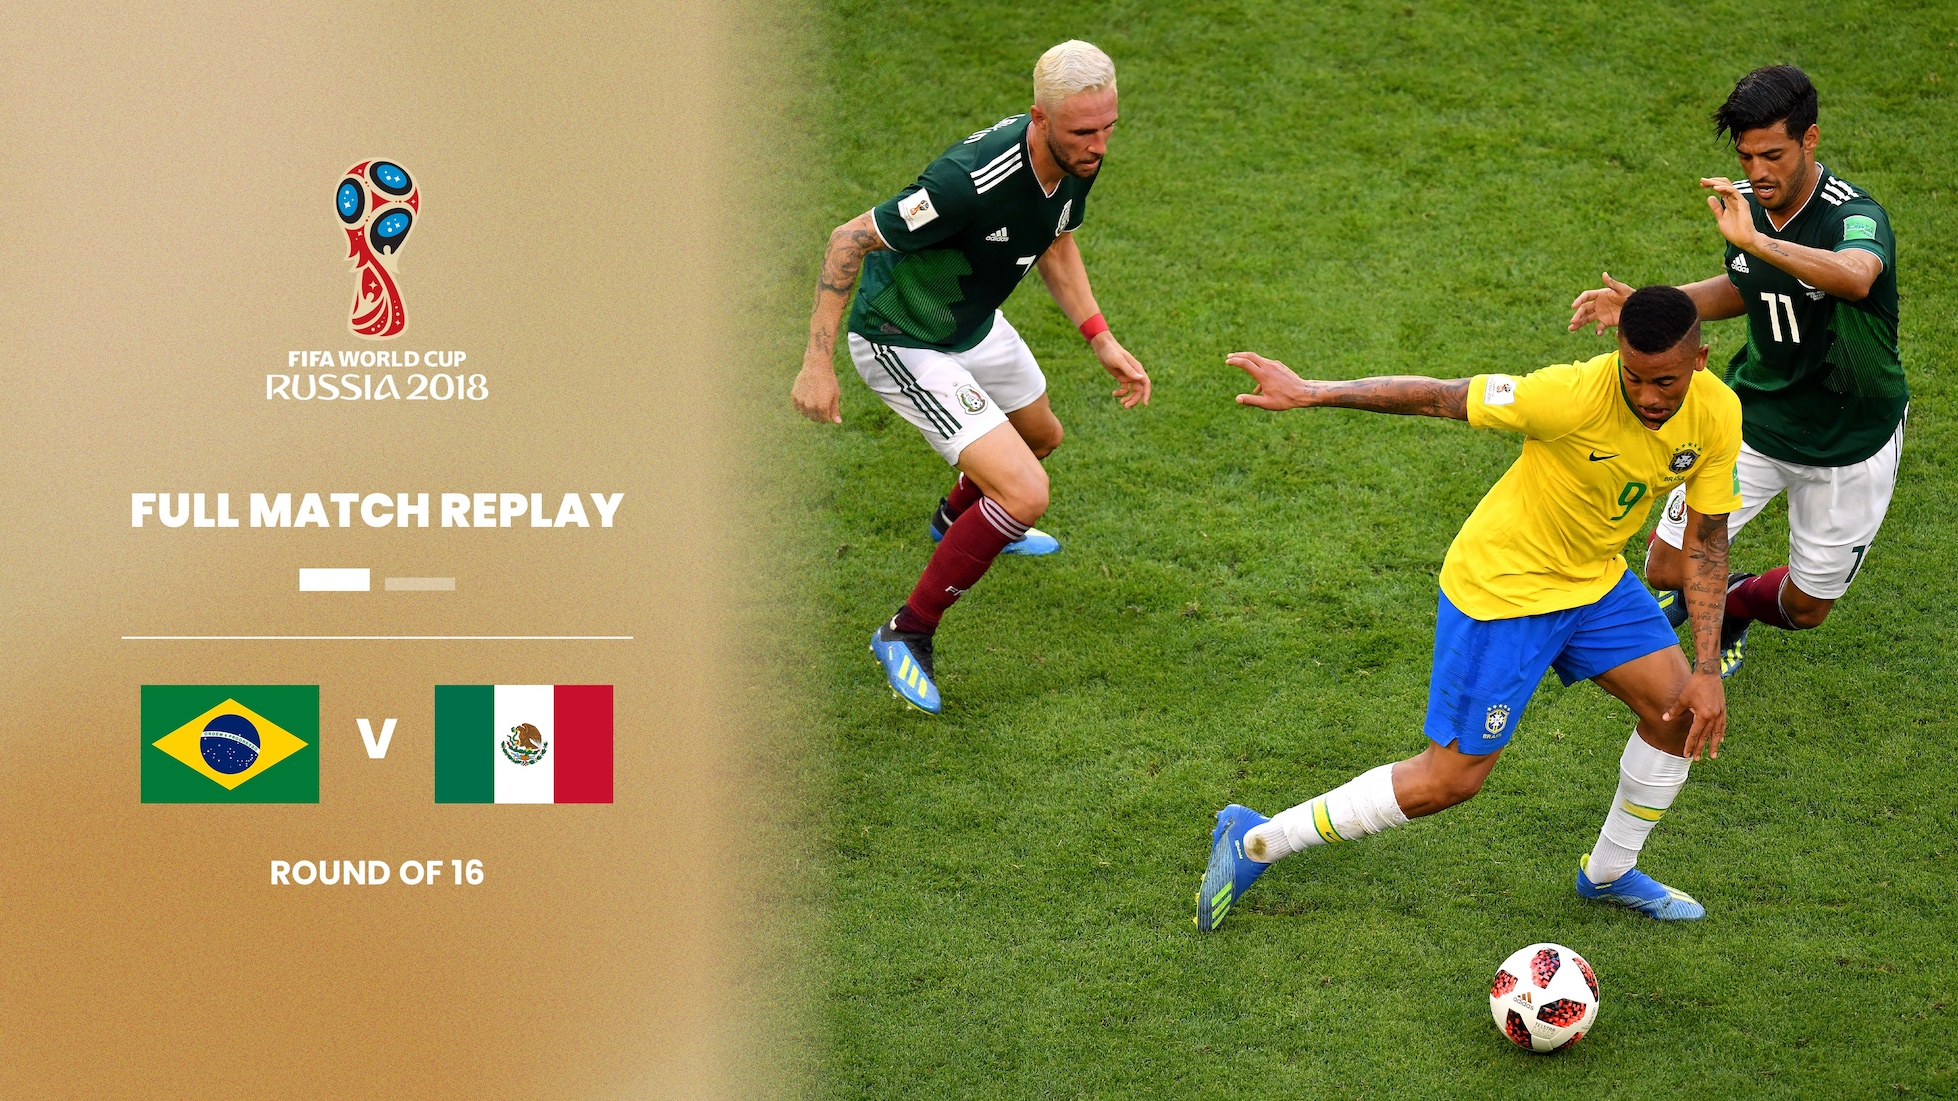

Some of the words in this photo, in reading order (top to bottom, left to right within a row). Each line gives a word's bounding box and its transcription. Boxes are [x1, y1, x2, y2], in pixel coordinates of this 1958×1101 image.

[1015, 254, 1037, 277] 7
[1760, 292, 1800, 344] 11
[1610, 481, 1647, 521] 9
[1513, 997, 1534, 1010] adidas
